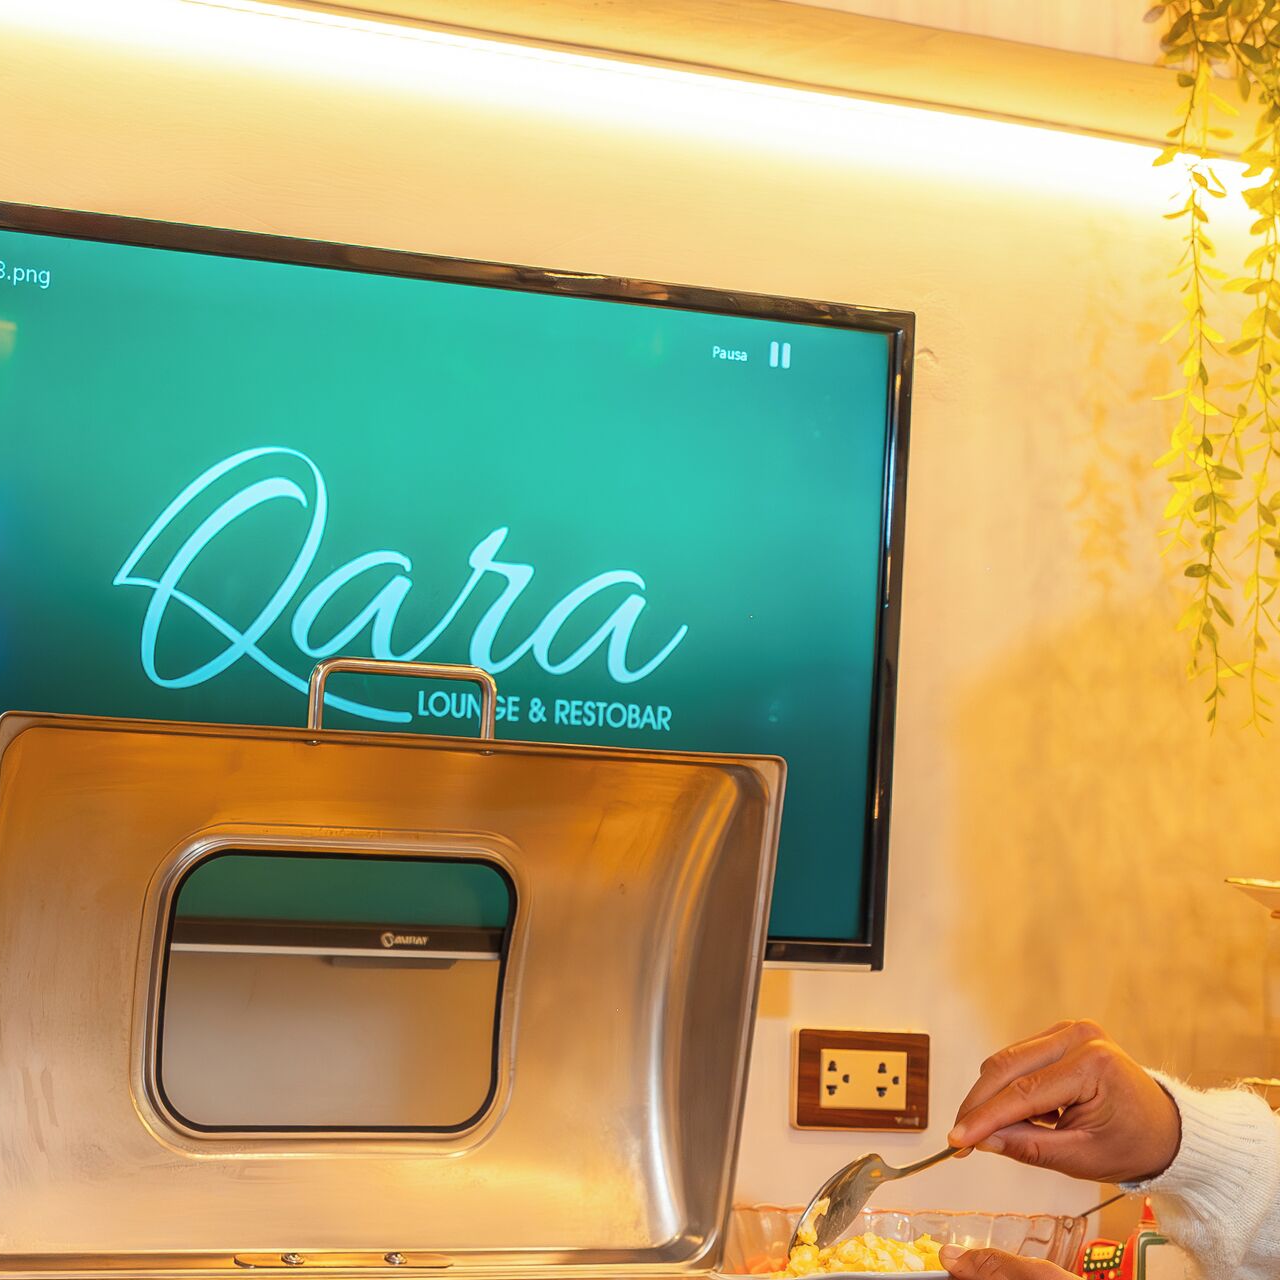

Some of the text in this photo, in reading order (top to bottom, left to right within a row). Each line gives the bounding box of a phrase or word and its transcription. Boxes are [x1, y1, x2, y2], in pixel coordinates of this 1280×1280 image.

[712, 345, 748, 361] Pausa
[113, 446, 689, 723] Qara
[528, 697, 547, 723] &
[554, 699, 672, 731] RESTOBAR
